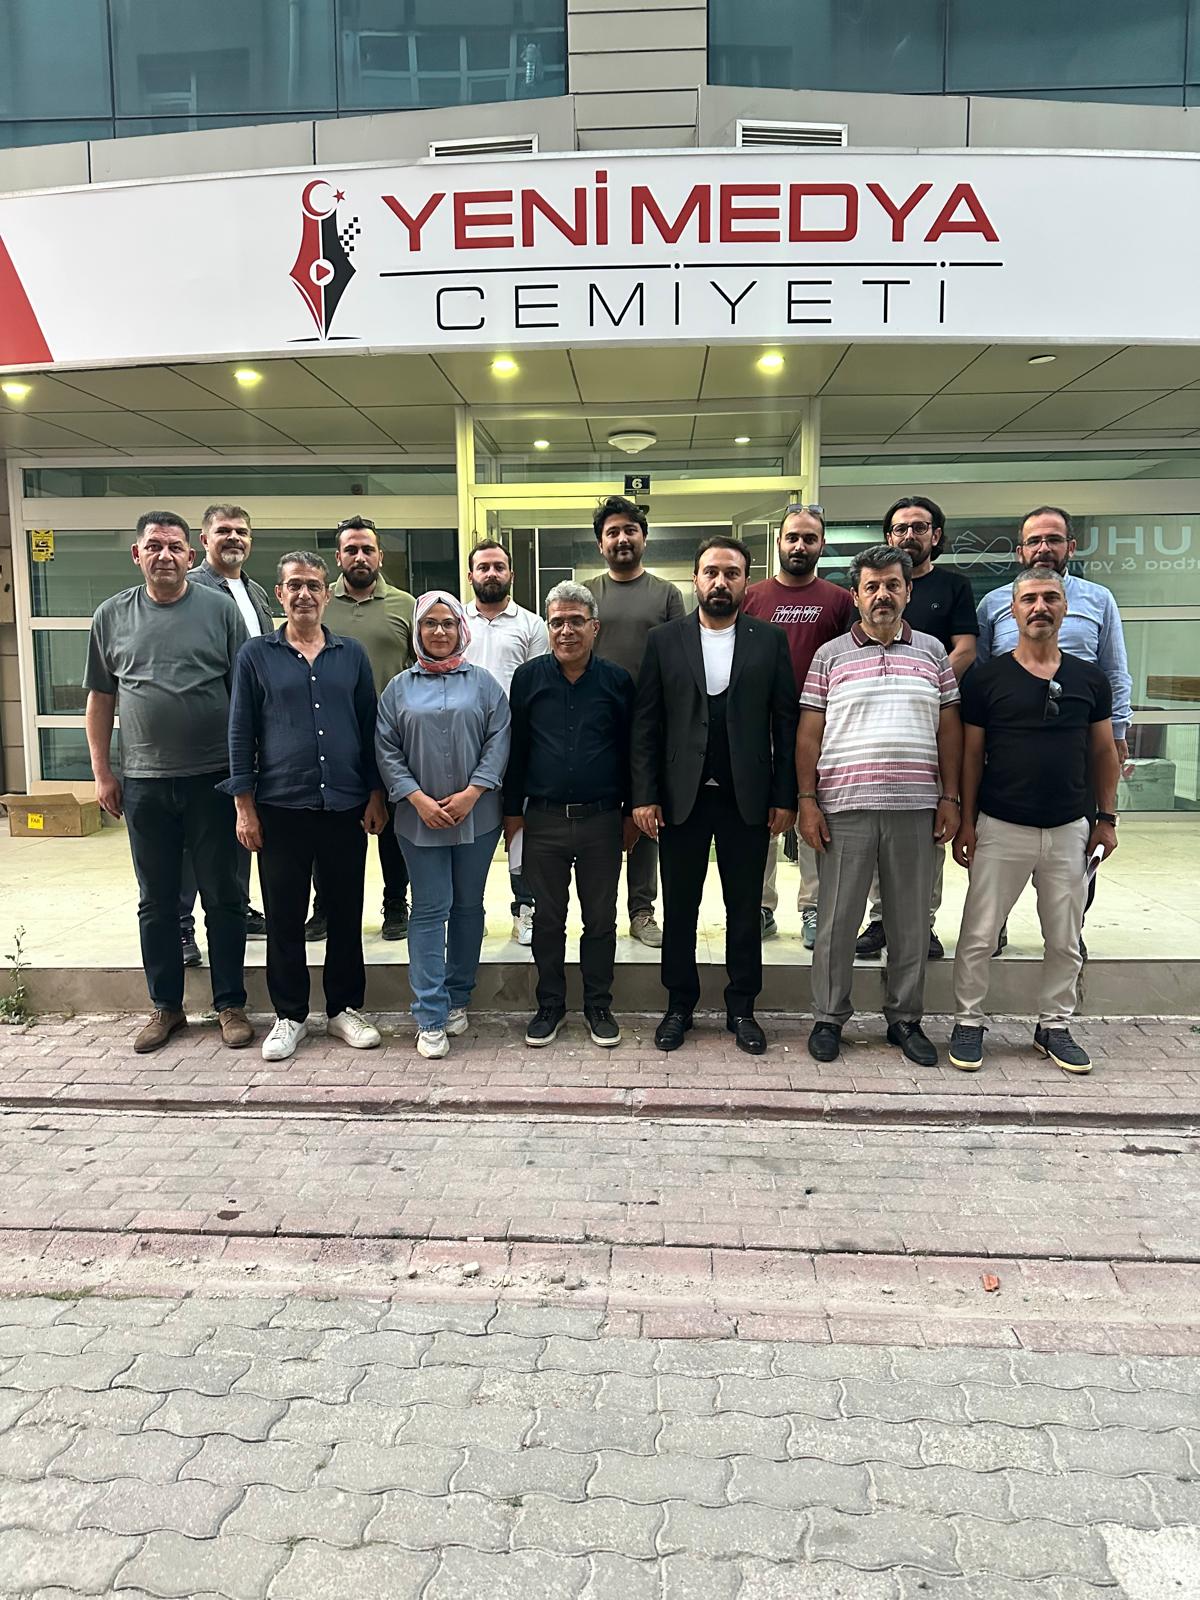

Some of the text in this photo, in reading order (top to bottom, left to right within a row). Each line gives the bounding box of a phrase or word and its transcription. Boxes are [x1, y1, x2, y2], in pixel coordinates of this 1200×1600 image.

[381, 170, 1000, 252] YENİ MEDYA
[436, 262, 946, 330] CEMİYETİ
[632, 478, 643, 489] 6
